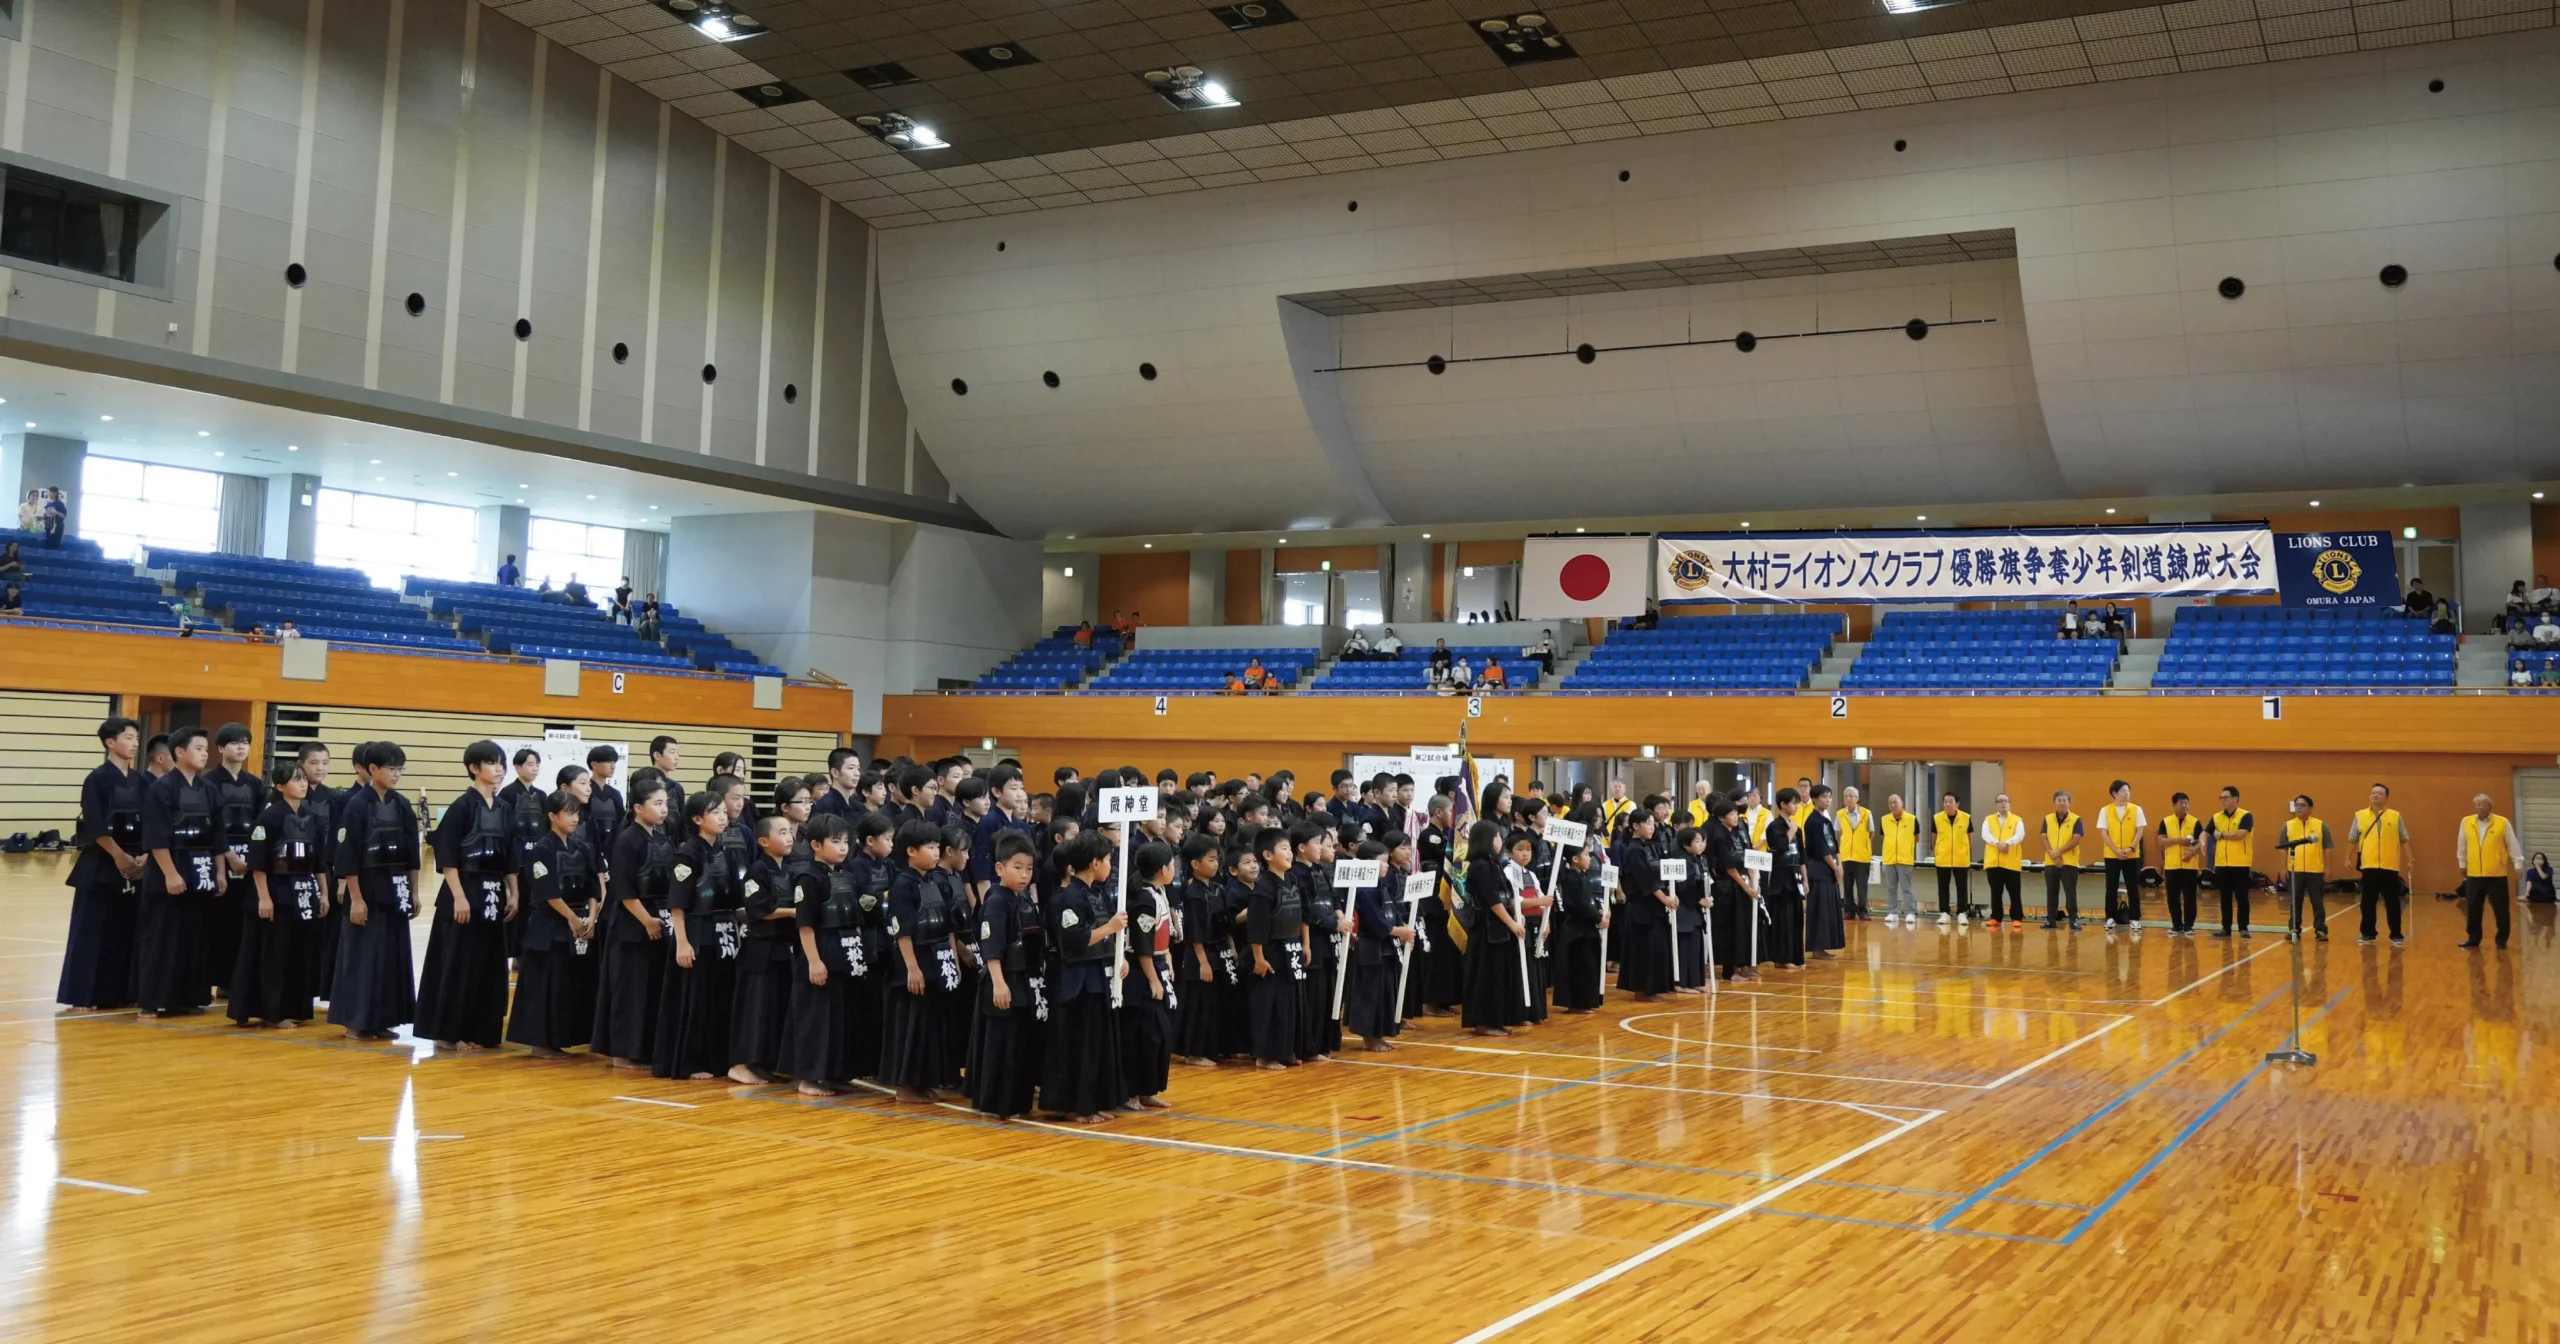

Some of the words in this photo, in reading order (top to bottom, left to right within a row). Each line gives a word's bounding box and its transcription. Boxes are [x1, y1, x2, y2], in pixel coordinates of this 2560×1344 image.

[2288, 536, 2332, 549] LIONS
[2339, 535, 2378, 547] CLUB
[2321, 551, 2349, 561] LIONS
[1686, 562, 1699, 577] L
[2331, 563, 2345, 578] L
[2306, 597, 2339, 605] OMURA
[2343, 595, 2376, 604] JAPAN
[614, 674, 623, 691] C
[1155, 698, 1166, 713] 4
[1469, 698, 1480, 716] 3
[1832, 697, 1846, 717] 2
[2264, 697, 2280, 719] 1
[1415, 754, 1449, 762] 第2試合場
